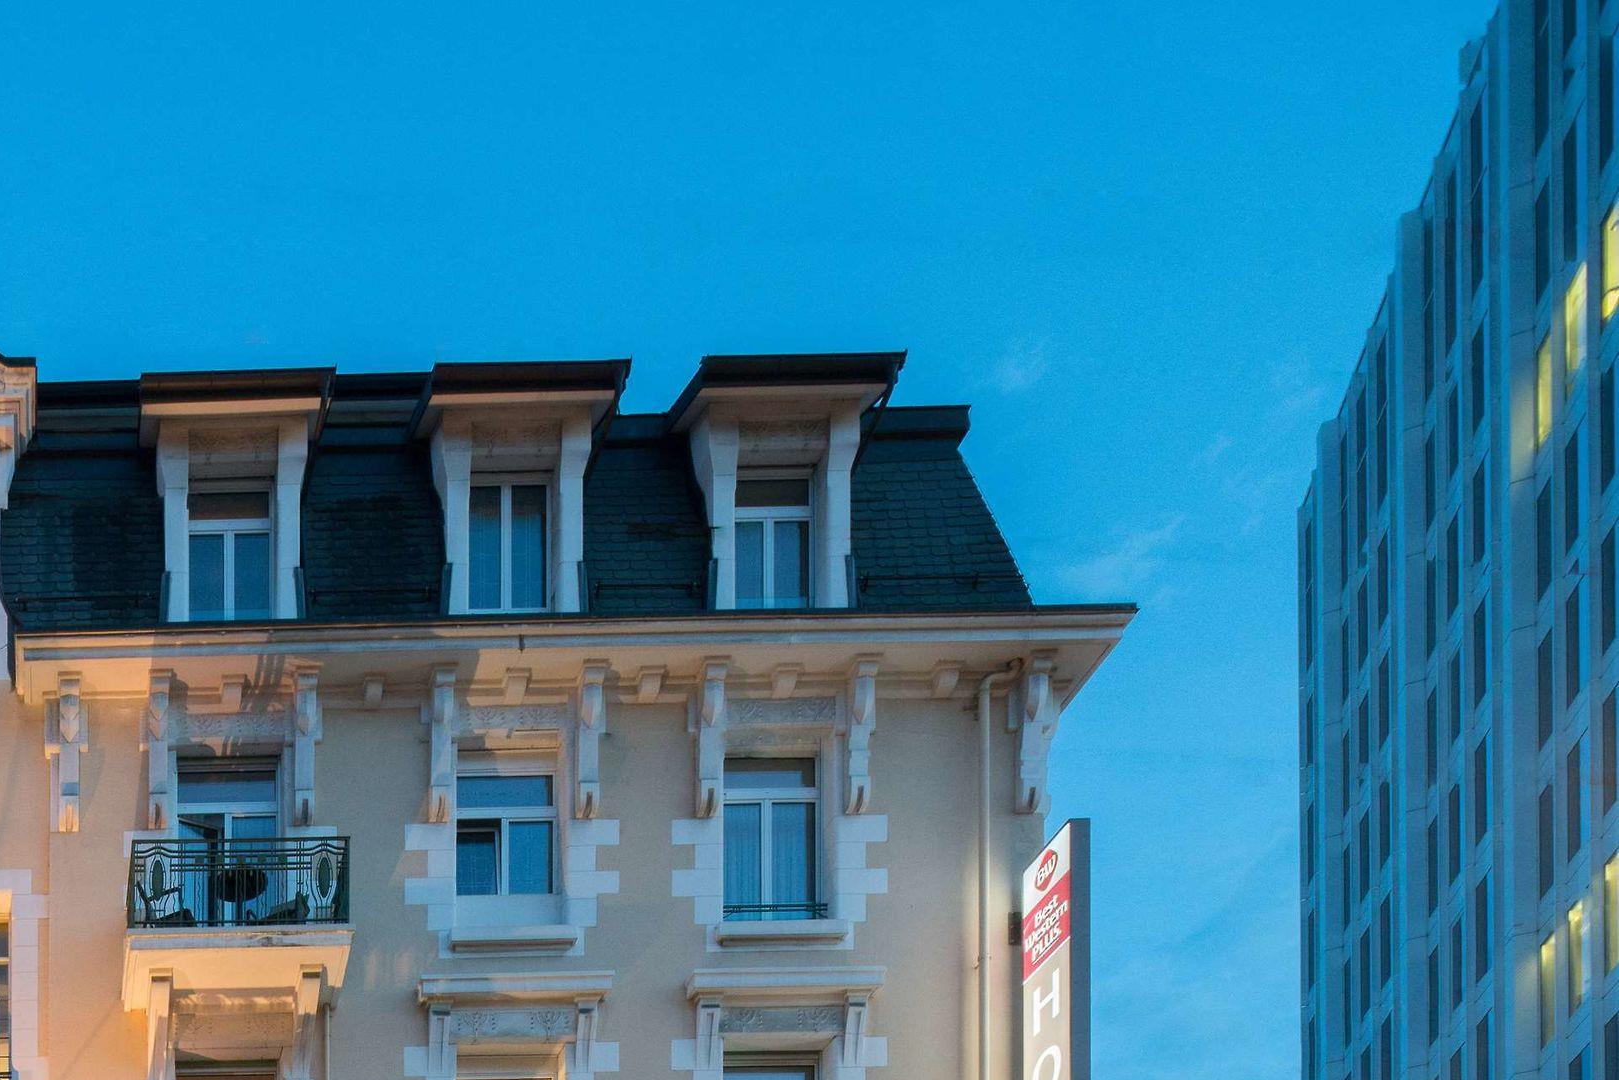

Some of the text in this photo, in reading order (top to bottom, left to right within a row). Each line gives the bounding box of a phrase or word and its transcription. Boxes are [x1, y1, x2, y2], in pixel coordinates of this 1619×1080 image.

[1037, 853, 1057, 885] BW
[1024, 899, 1069, 953] Western
[1034, 893, 1059, 929] Best
